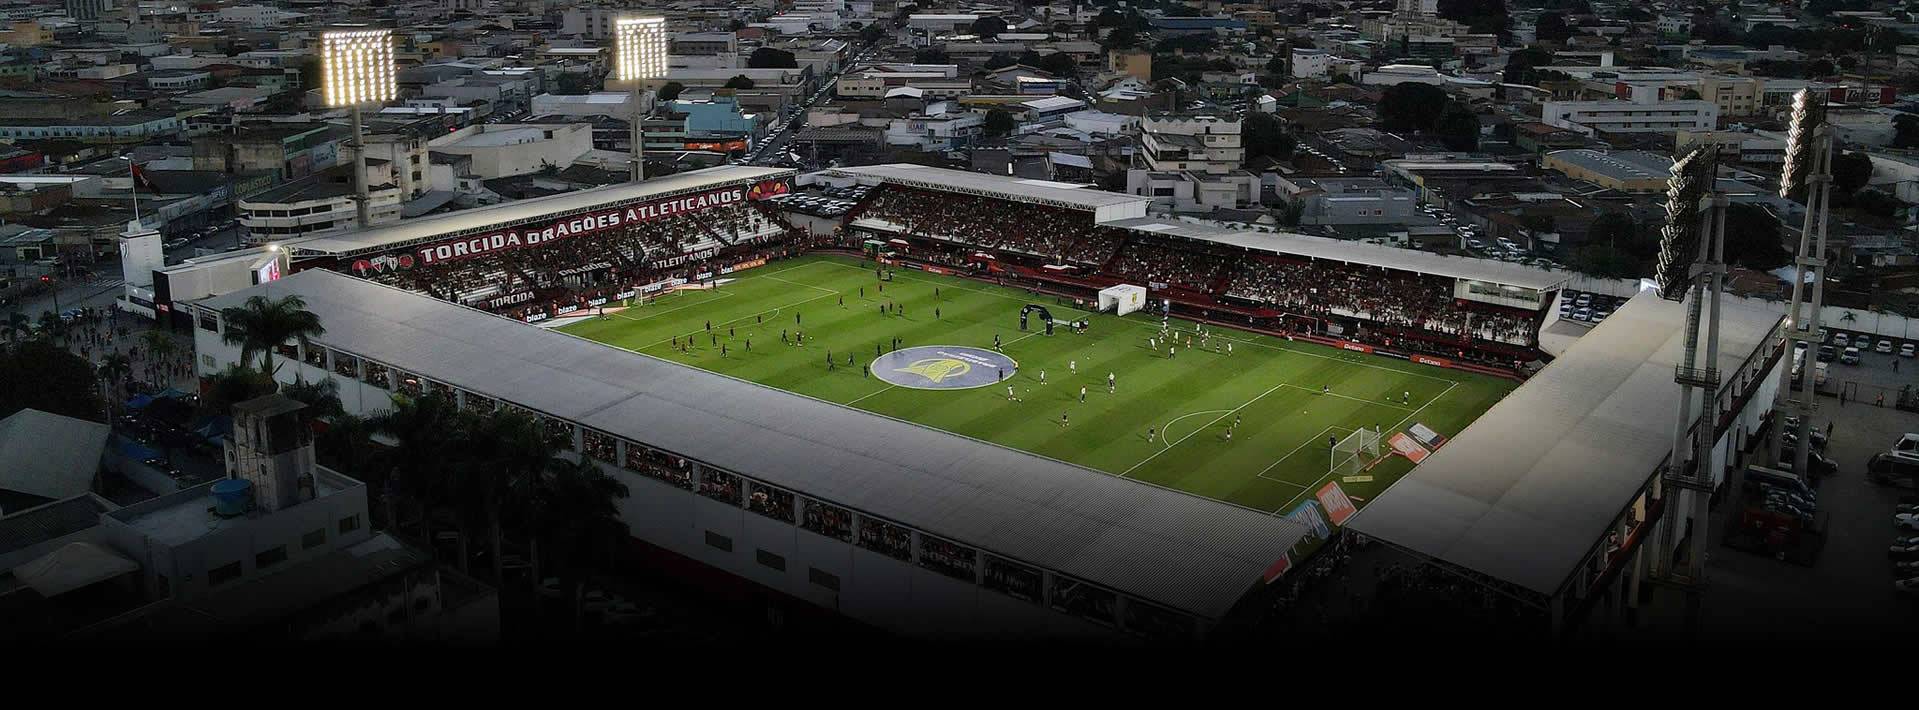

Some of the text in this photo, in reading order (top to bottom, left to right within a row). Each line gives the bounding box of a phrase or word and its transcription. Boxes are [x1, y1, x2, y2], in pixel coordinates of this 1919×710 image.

[420, 189, 742, 262] TORCIDA DRAGÕES ATLETICANOS
[652, 248, 713, 270] ATLETICANOS
[489, 291, 536, 308] TORCIDA
[616, 290, 635, 301] blaze
[588, 297, 607, 307] blaze
[558, 304, 578, 315] blaze
[526, 311, 547, 323] blaze
